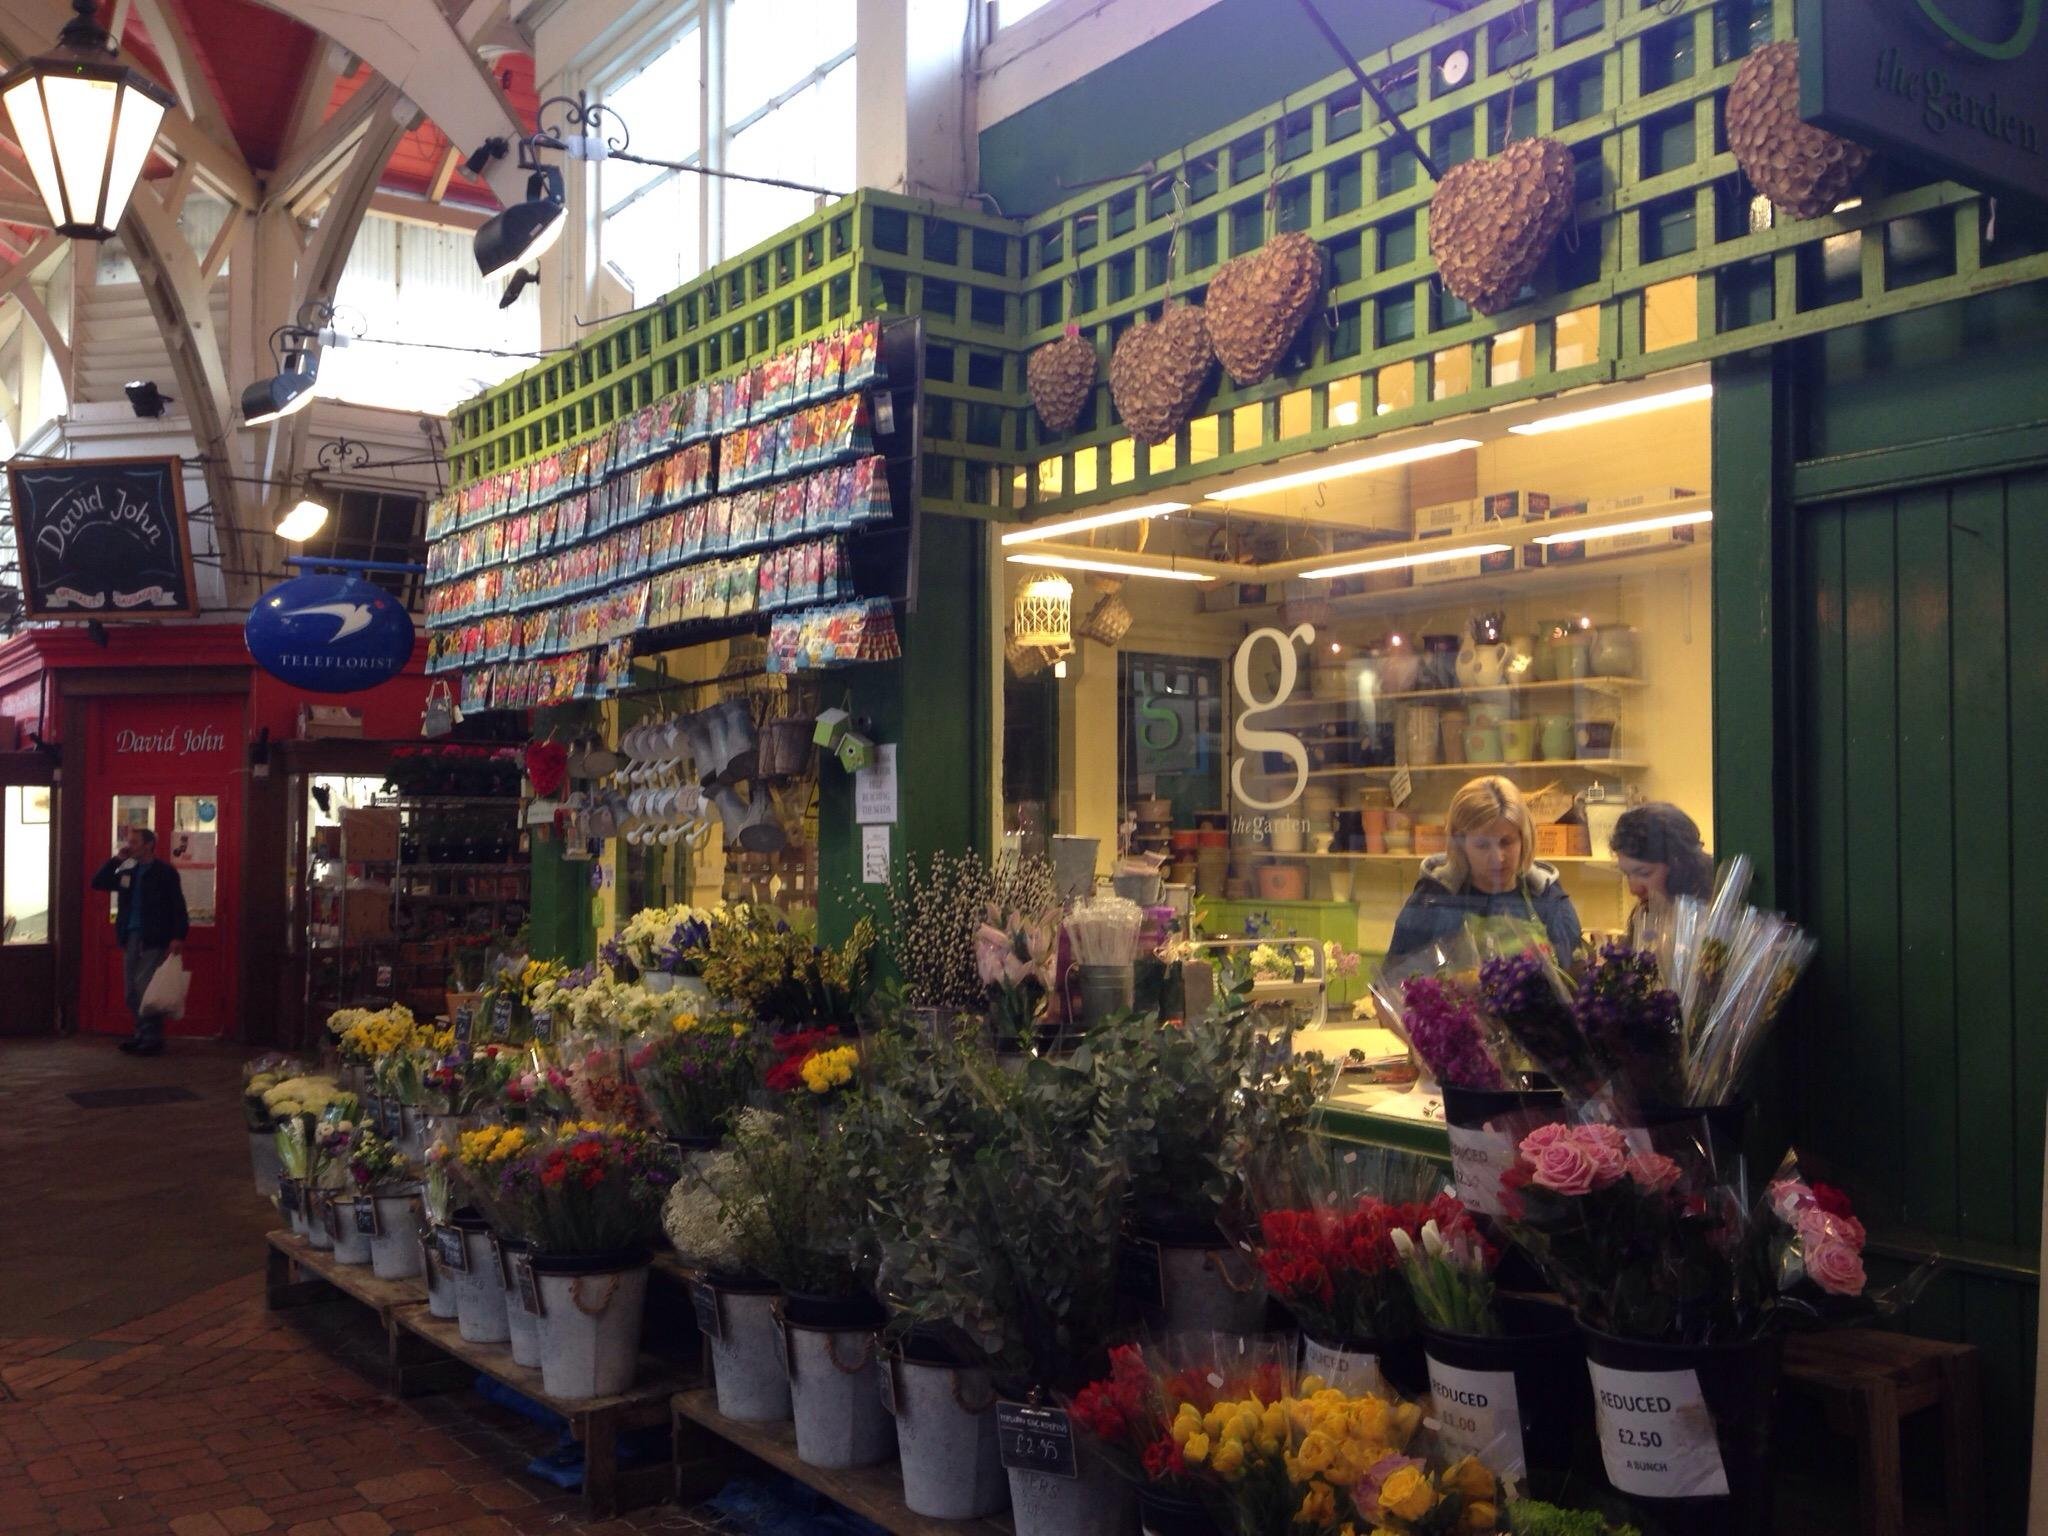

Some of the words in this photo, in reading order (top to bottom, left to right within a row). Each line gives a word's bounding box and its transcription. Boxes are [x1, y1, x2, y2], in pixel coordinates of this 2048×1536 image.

[37, 485, 104, 560] David
[110, 487, 161, 546] John
[280, 655, 395, 669] TELEFLORIST
[116, 725, 180, 753] David
[180, 724, 225, 756] John
[1600, 1389, 1671, 1413] REDUCED
[1618, 1428, 1663, 1448] £2.50
[1626, 1459, 1634, 1470] A
[1634, 1459, 1668, 1473] BUNCH
